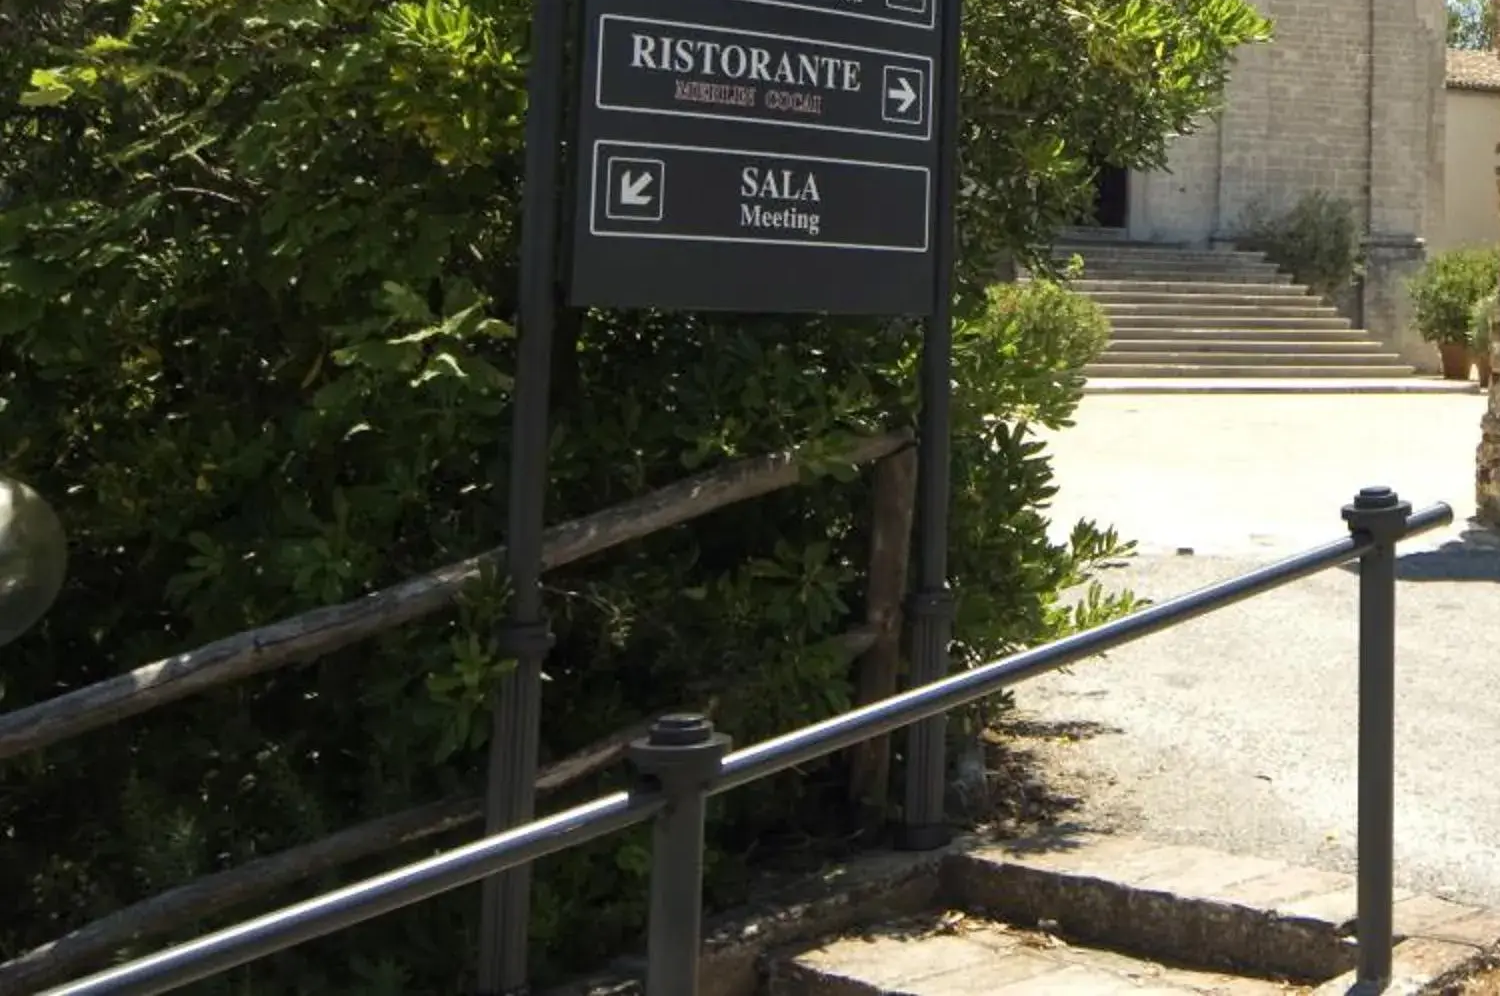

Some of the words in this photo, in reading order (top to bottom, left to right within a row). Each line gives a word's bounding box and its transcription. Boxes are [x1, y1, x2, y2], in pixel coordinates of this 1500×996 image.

[631, 32, 862, 93] RISTORANTE
[740, 166, 821, 202] SALA
[740, 203, 820, 235] Meeting
